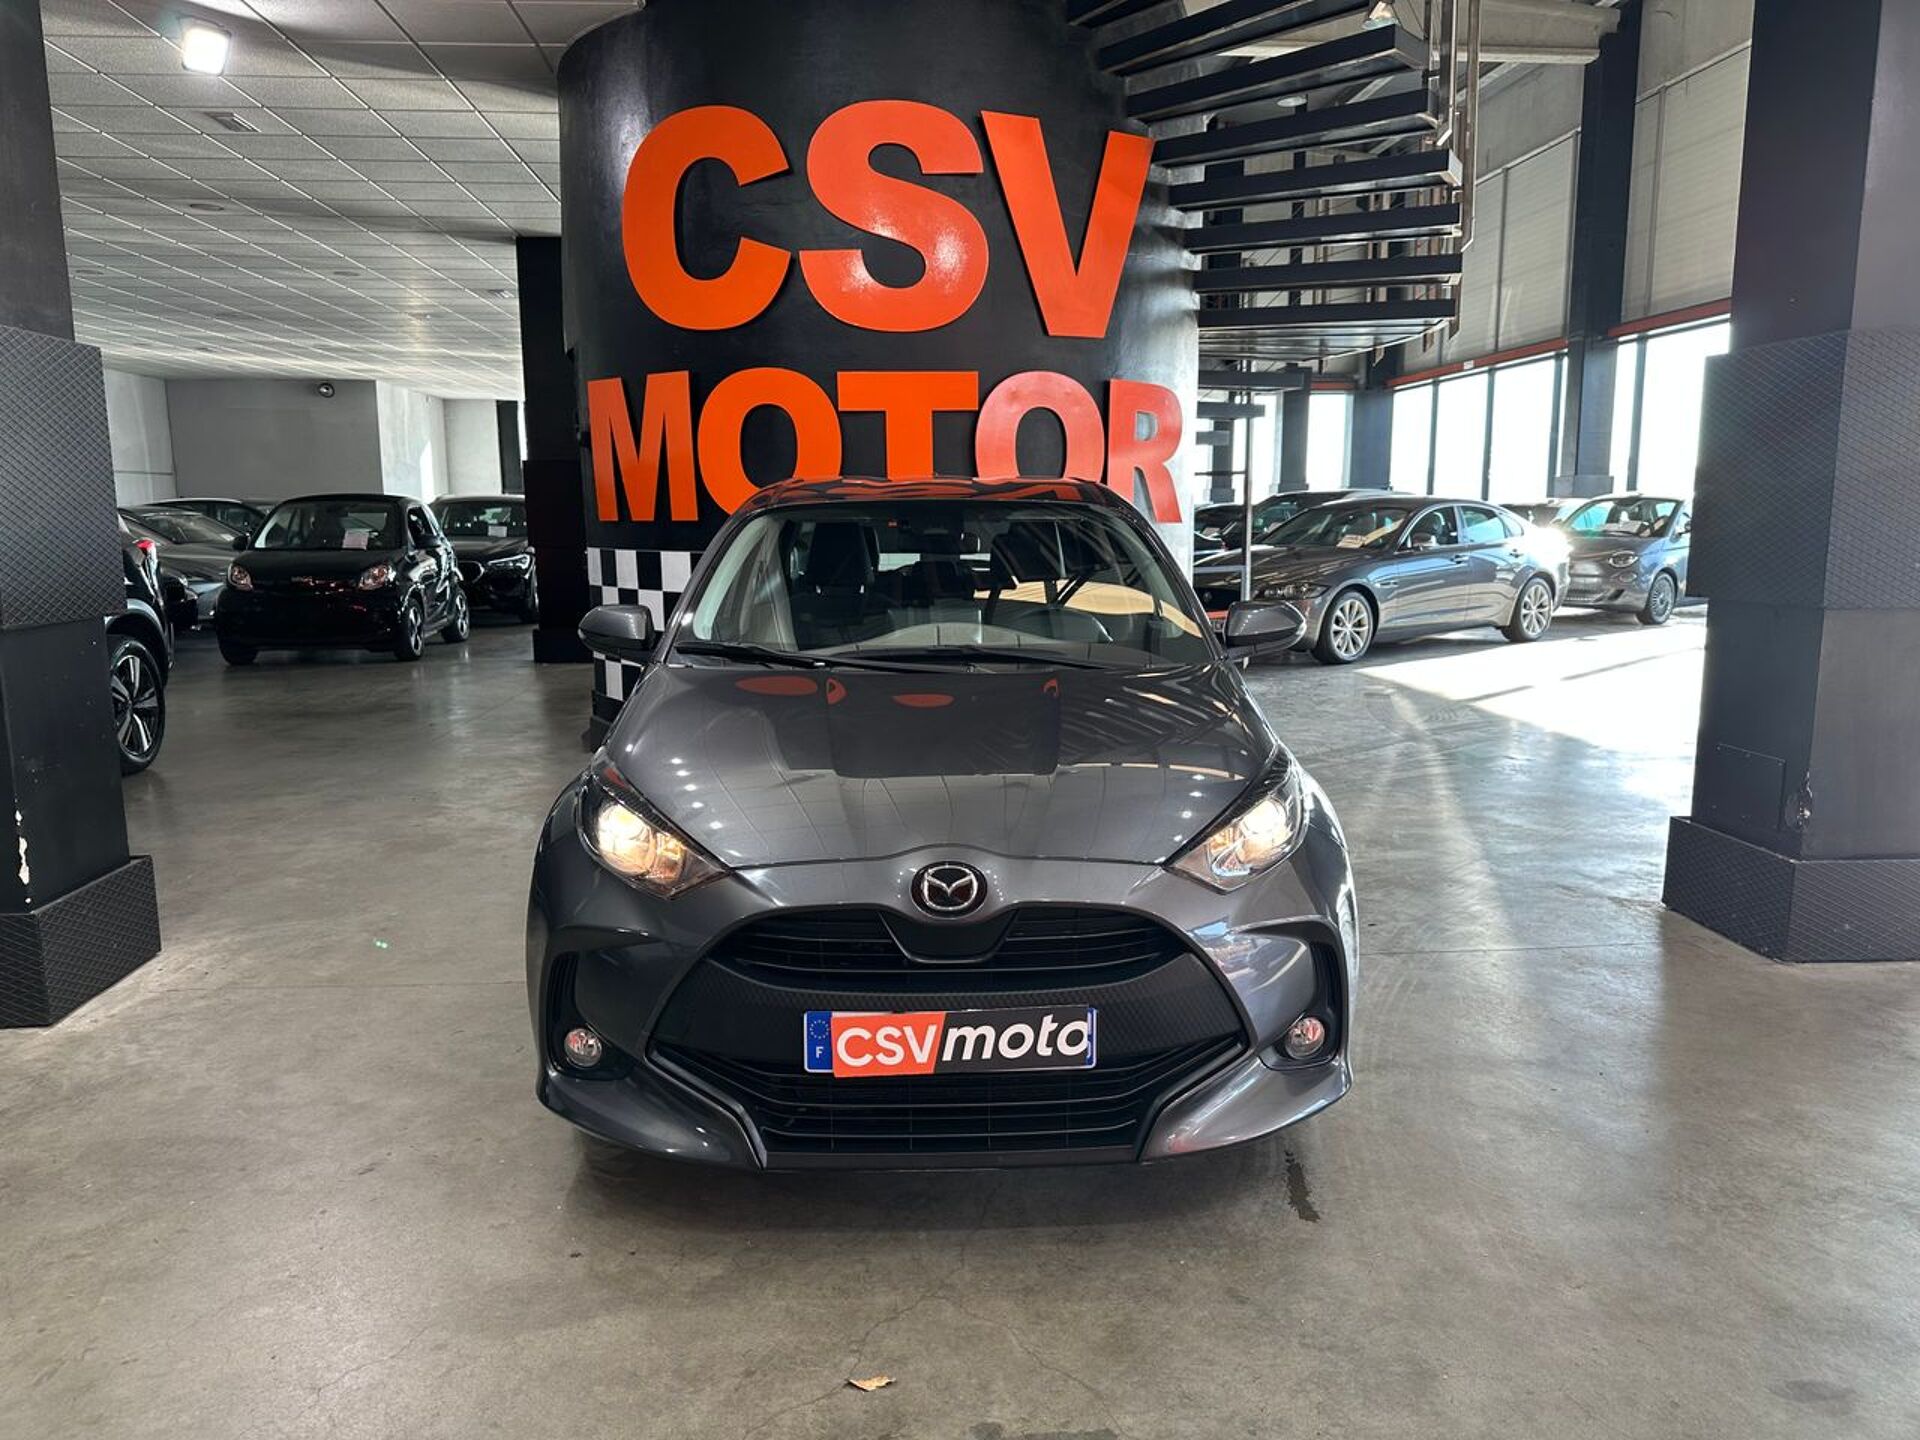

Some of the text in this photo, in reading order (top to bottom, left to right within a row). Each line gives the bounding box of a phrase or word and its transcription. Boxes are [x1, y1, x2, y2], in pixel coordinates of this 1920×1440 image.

[622, 99, 1154, 338] CSV
[588, 366, 1182, 523] MOTOR
[815, 1046, 825, 1059] F
